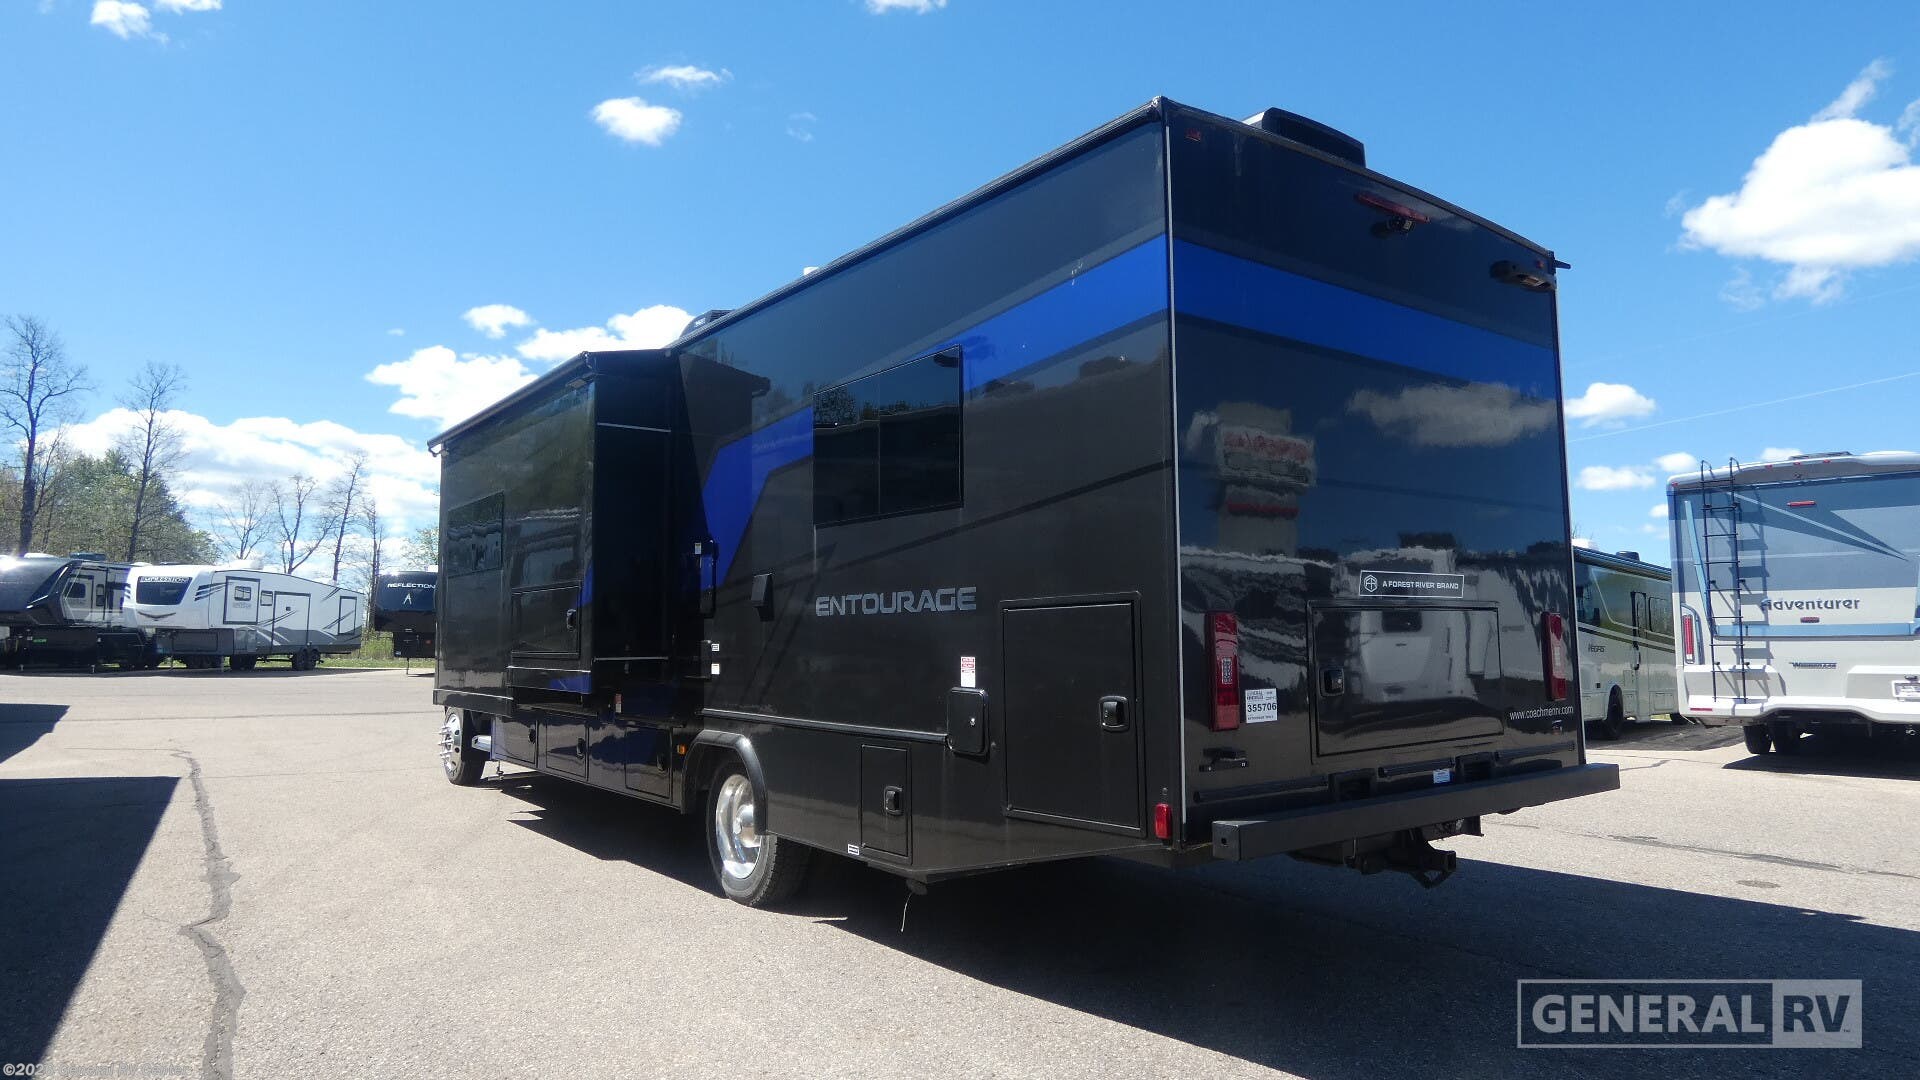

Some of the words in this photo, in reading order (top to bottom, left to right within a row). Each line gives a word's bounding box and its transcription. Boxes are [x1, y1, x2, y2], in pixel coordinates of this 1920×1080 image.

[1388, 580, 1414, 588] FOREST
[1416, 581, 1435, 589] RIVER
[1436, 582, 1459, 590] BRAND
[815, 586, 977, 617] ENTOURAGE
[1760, 598, 1860, 611] Adventurer
[1247, 702, 1277, 712] 355706
